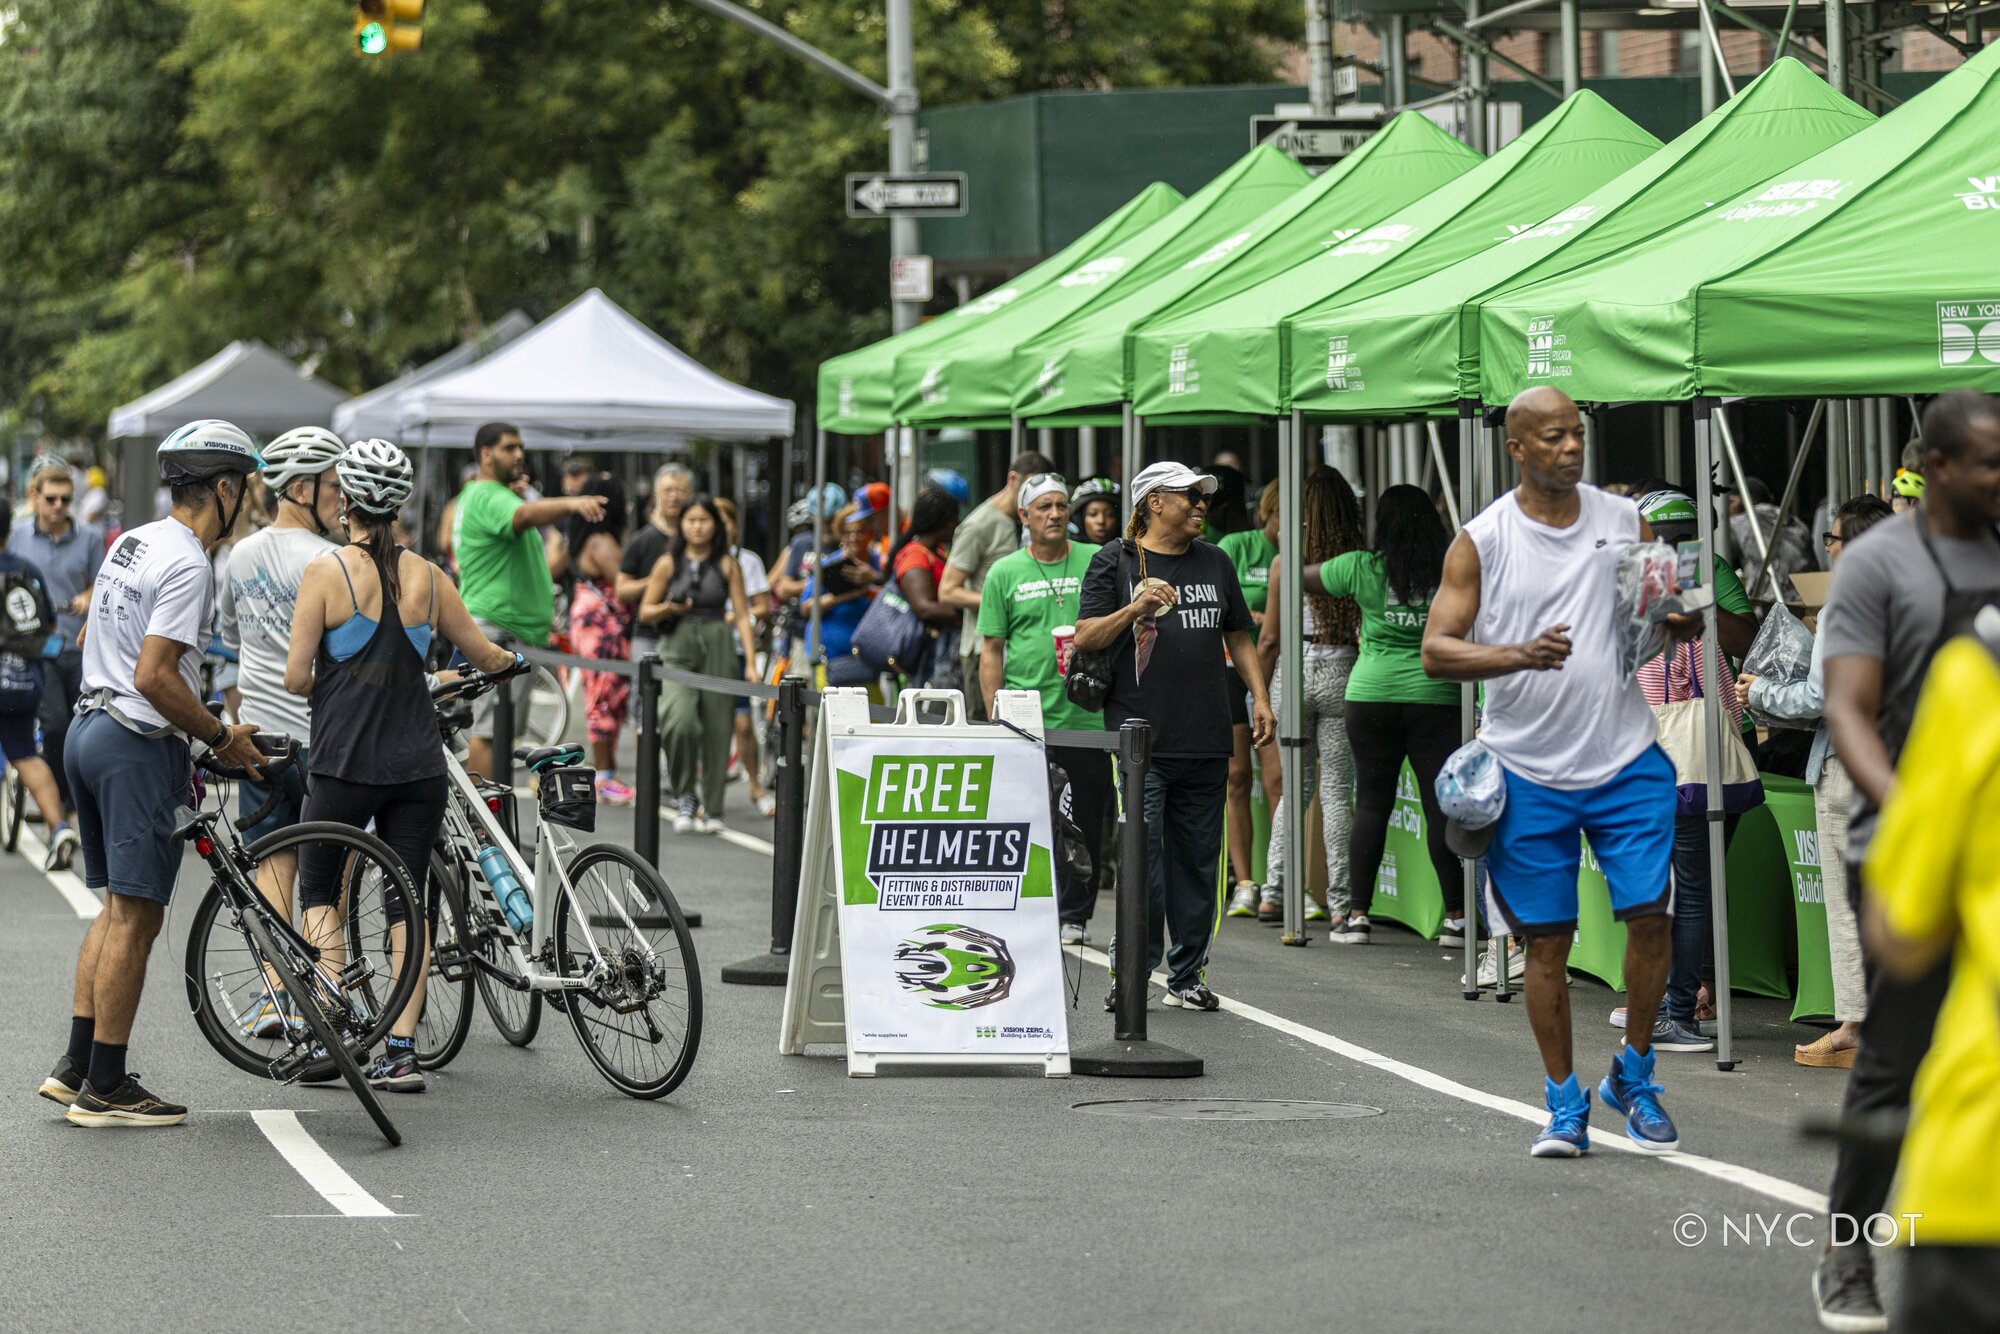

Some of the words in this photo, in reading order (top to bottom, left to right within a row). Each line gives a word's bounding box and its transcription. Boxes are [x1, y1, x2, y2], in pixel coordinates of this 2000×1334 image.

[1277, 133, 1318, 153] ONE
[1940, 305, 1969, 318] NEW
[204, 440, 229, 450] VISION
[229, 443, 246, 454] ZERO
[1175, 585, 1182, 605] I
[1184, 584, 1219, 604] SAW
[1177, 607, 1222, 629] THAT!
[876, 763, 982, 813] FREE
[1403, 805, 1421, 840] City
[878, 829, 1022, 867] HELMETS
[397, 865, 420, 905] KENDA
[888, 880, 929, 893] FITTING
[931, 880, 939, 893] &
[941, 880, 1014, 893] DISTRIBUTION
[886, 894, 920, 907] EVENT
[922, 894, 943, 906] FOR
[944, 894, 964, 906] ALL
